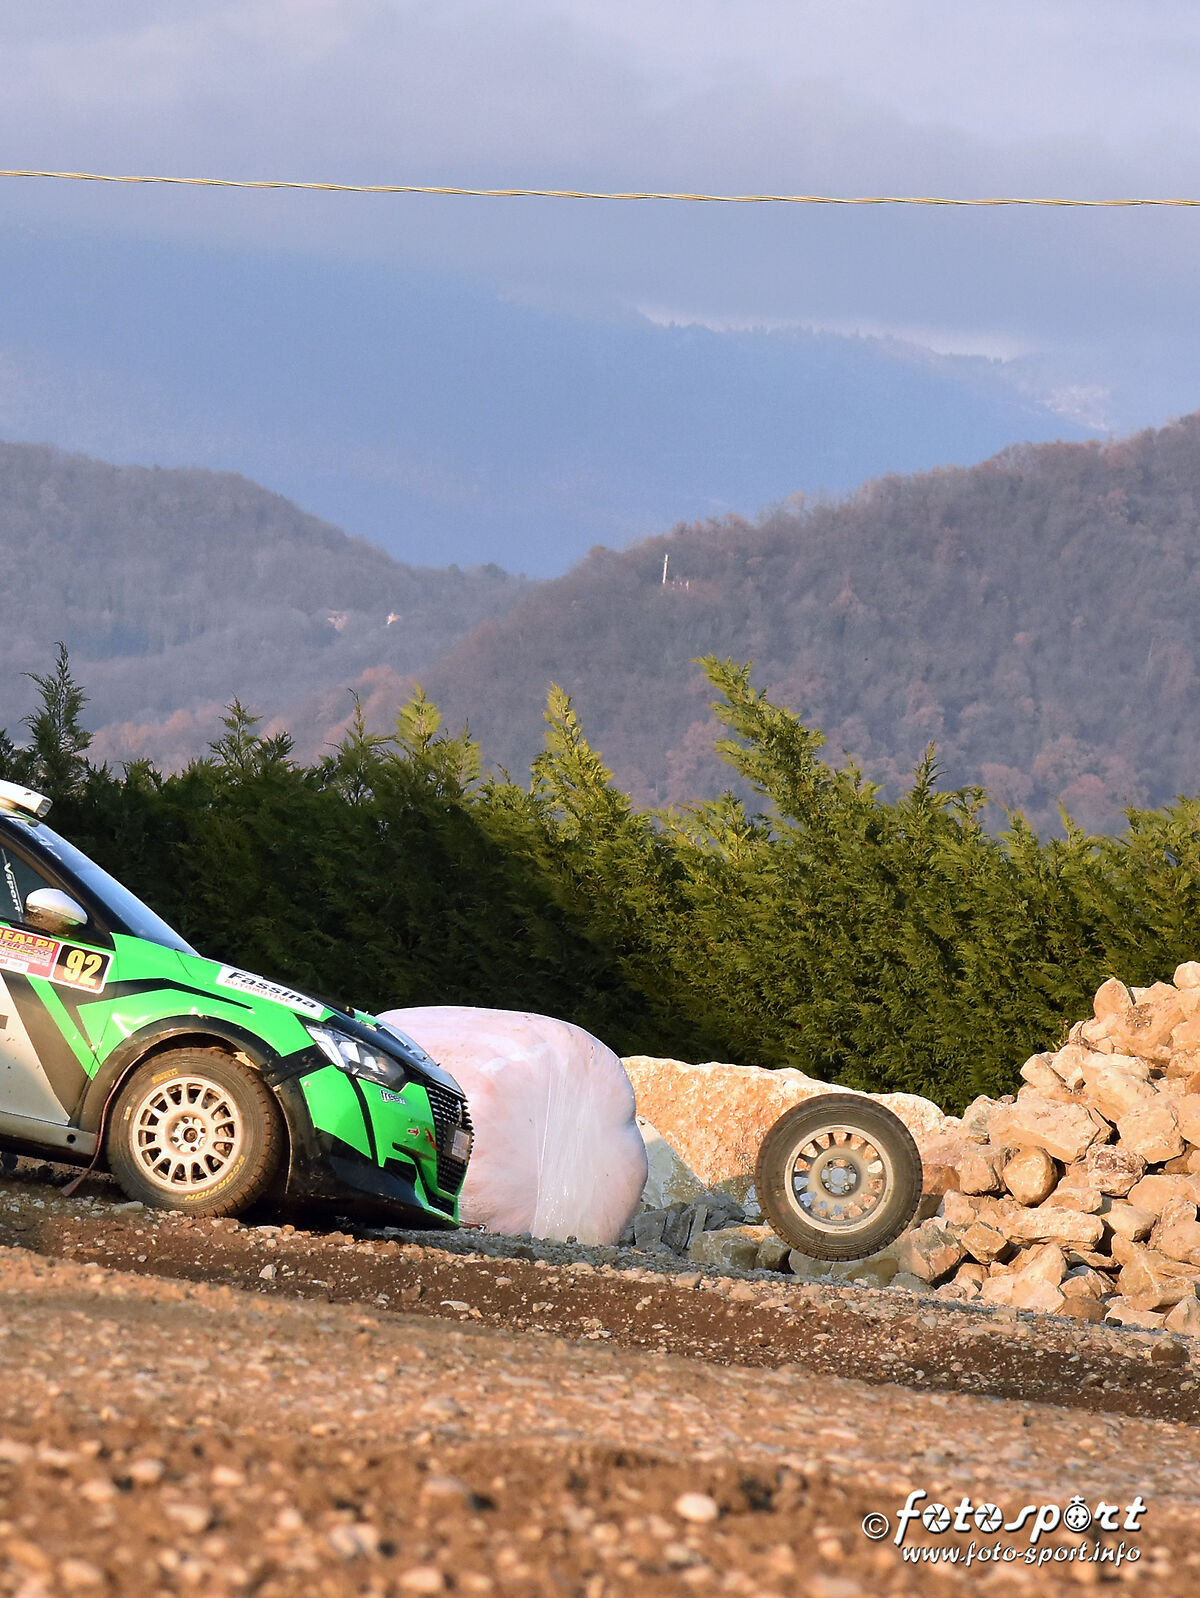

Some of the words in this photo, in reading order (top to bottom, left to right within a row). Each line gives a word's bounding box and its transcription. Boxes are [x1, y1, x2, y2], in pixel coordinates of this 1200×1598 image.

[63, 949, 103, 987] 92
[224, 979, 292, 1004] AUTOMOTIVE
[228, 971, 317, 1009] Fassina
